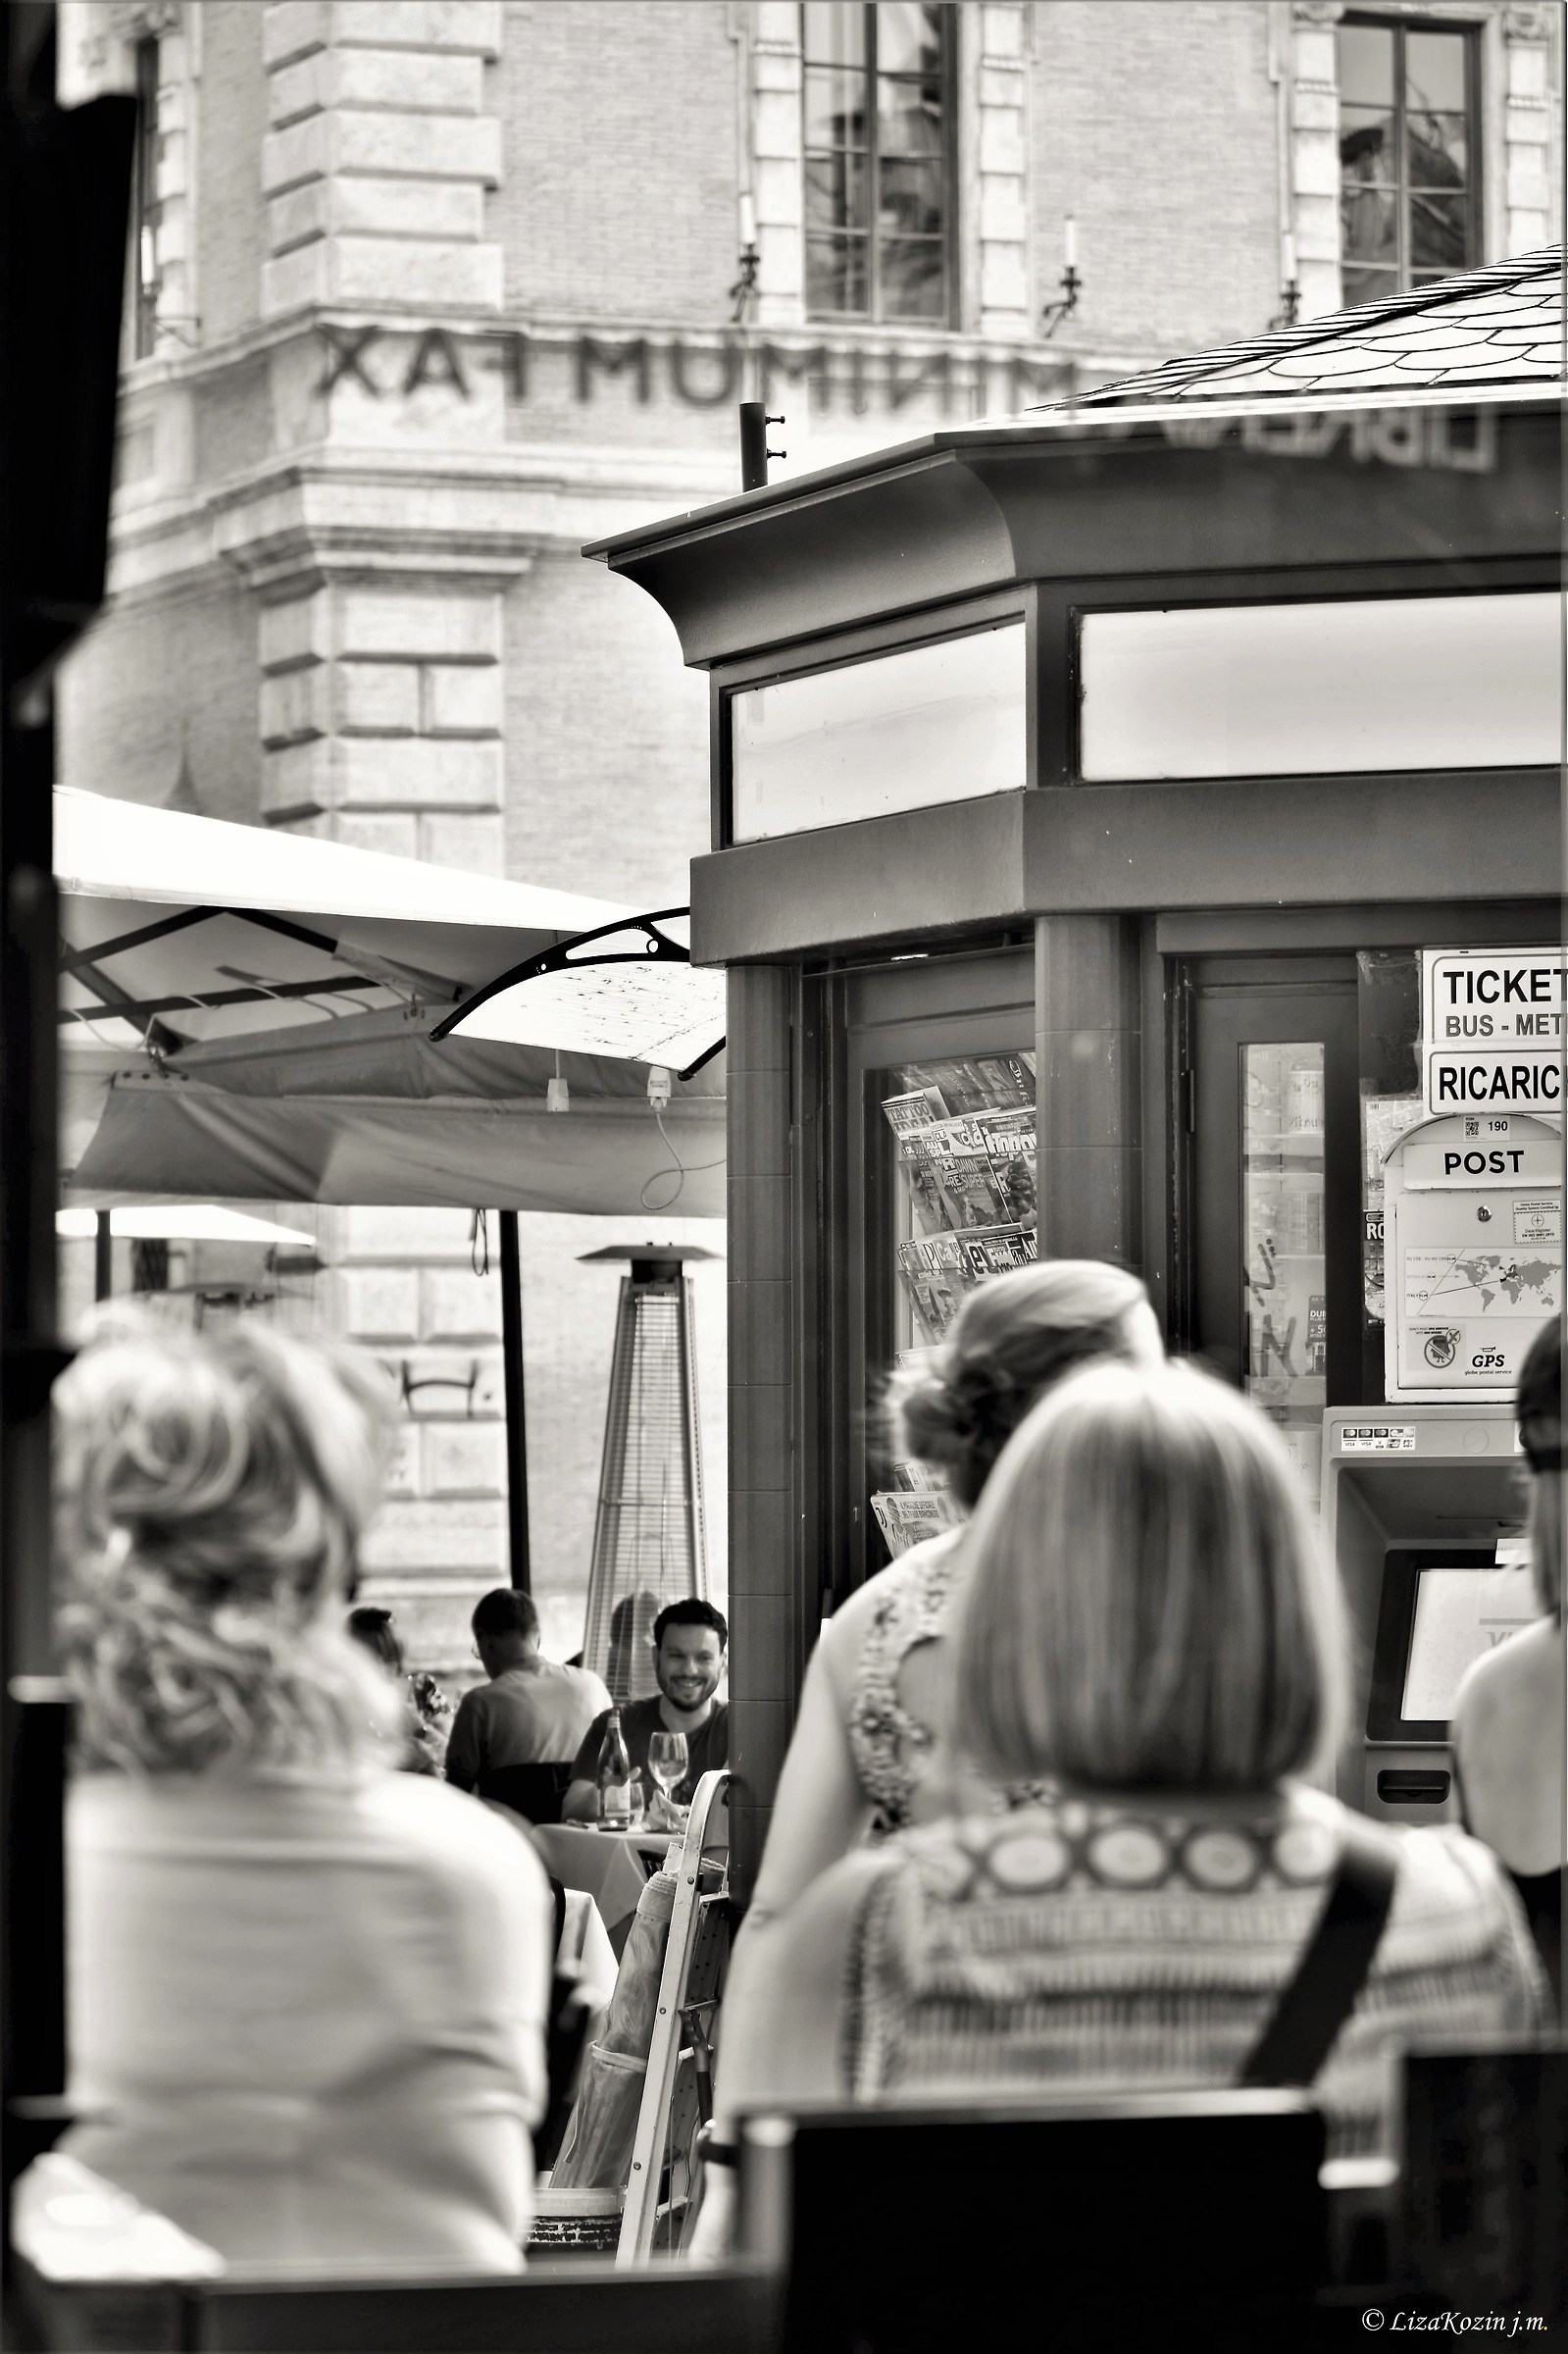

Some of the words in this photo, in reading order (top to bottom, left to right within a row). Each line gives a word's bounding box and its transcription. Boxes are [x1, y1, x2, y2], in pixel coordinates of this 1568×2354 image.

[1445, 1014, 1494, 1038] BUS
[1440, 1064, 1567, 1100] RICARIC
[887, 1102, 931, 1121] TATTOO
[1488, 1121, 1508, 1132] 190
[1443, 1151, 1525, 1175] POST
[1472, 1355, 1505, 1368] GPS
